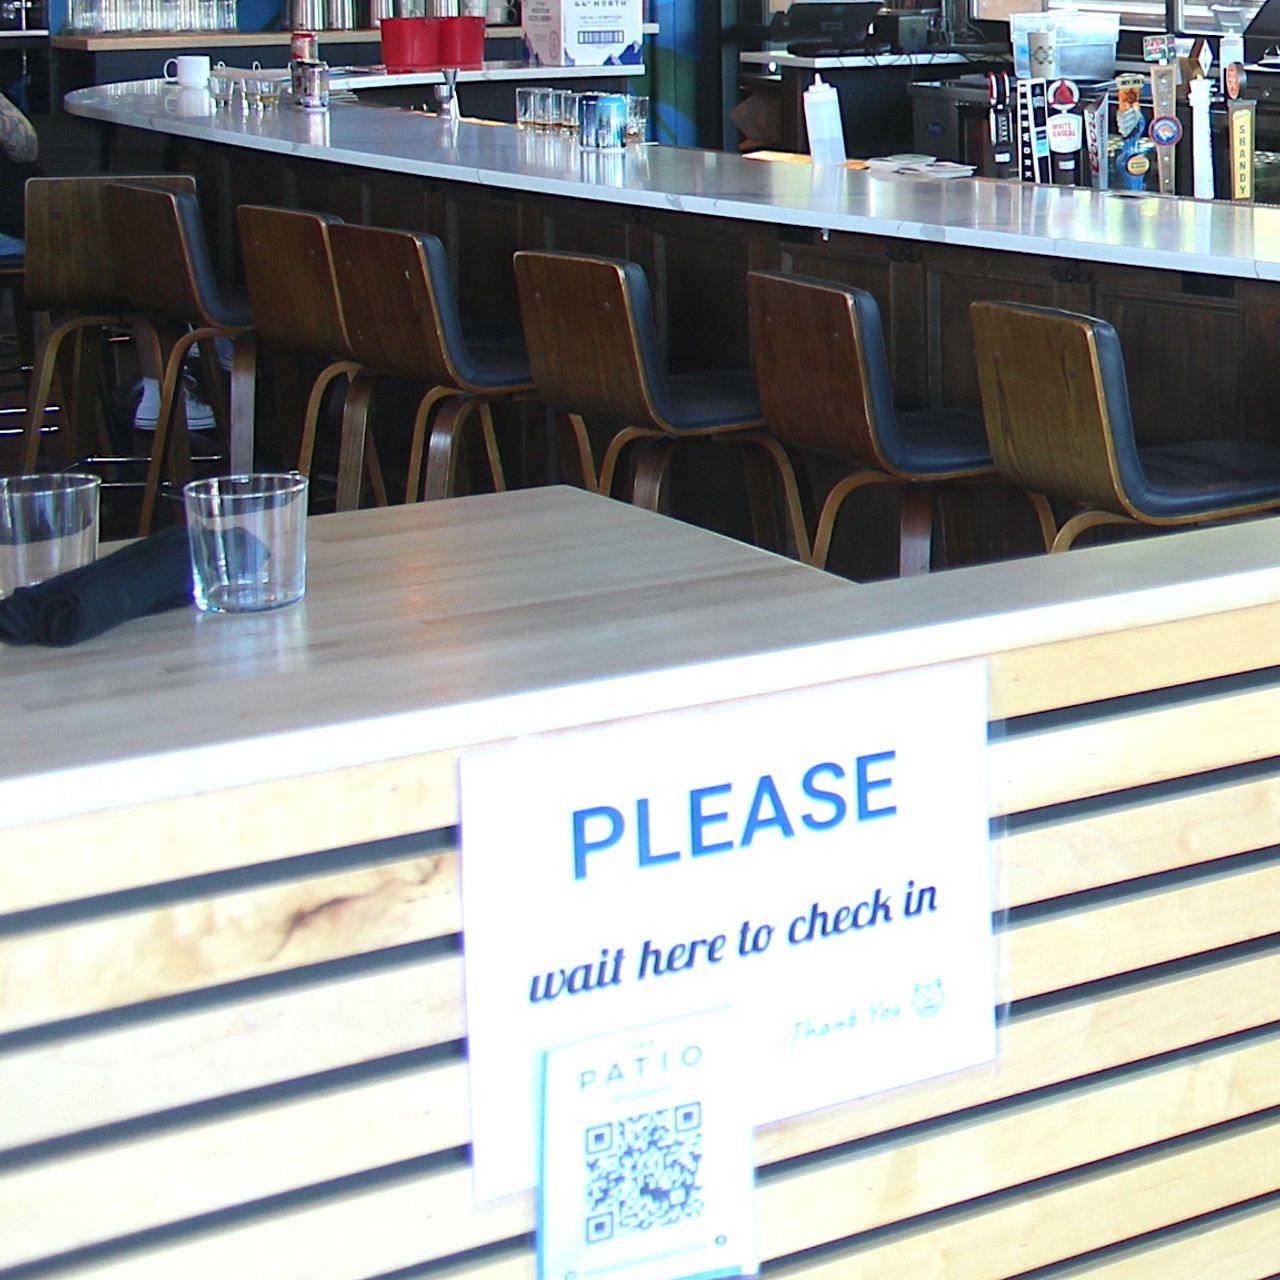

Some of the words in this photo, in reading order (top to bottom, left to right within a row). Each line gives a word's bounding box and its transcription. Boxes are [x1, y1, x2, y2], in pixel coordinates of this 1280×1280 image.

[1052, 122, 1072, 131] WHITE
[1239, 124, 1247, 195] SHANDY
[572, 750, 898, 881] PLEASE
[529, 947, 625, 1005] wait
[638, 931, 727, 981] here
[738, 920, 774, 959] to
[787, 887, 893, 945] check
[904, 880, 938, 918] in
[868, 999, 902, 1028] You
[579, 1045, 703, 1093] PATIO
